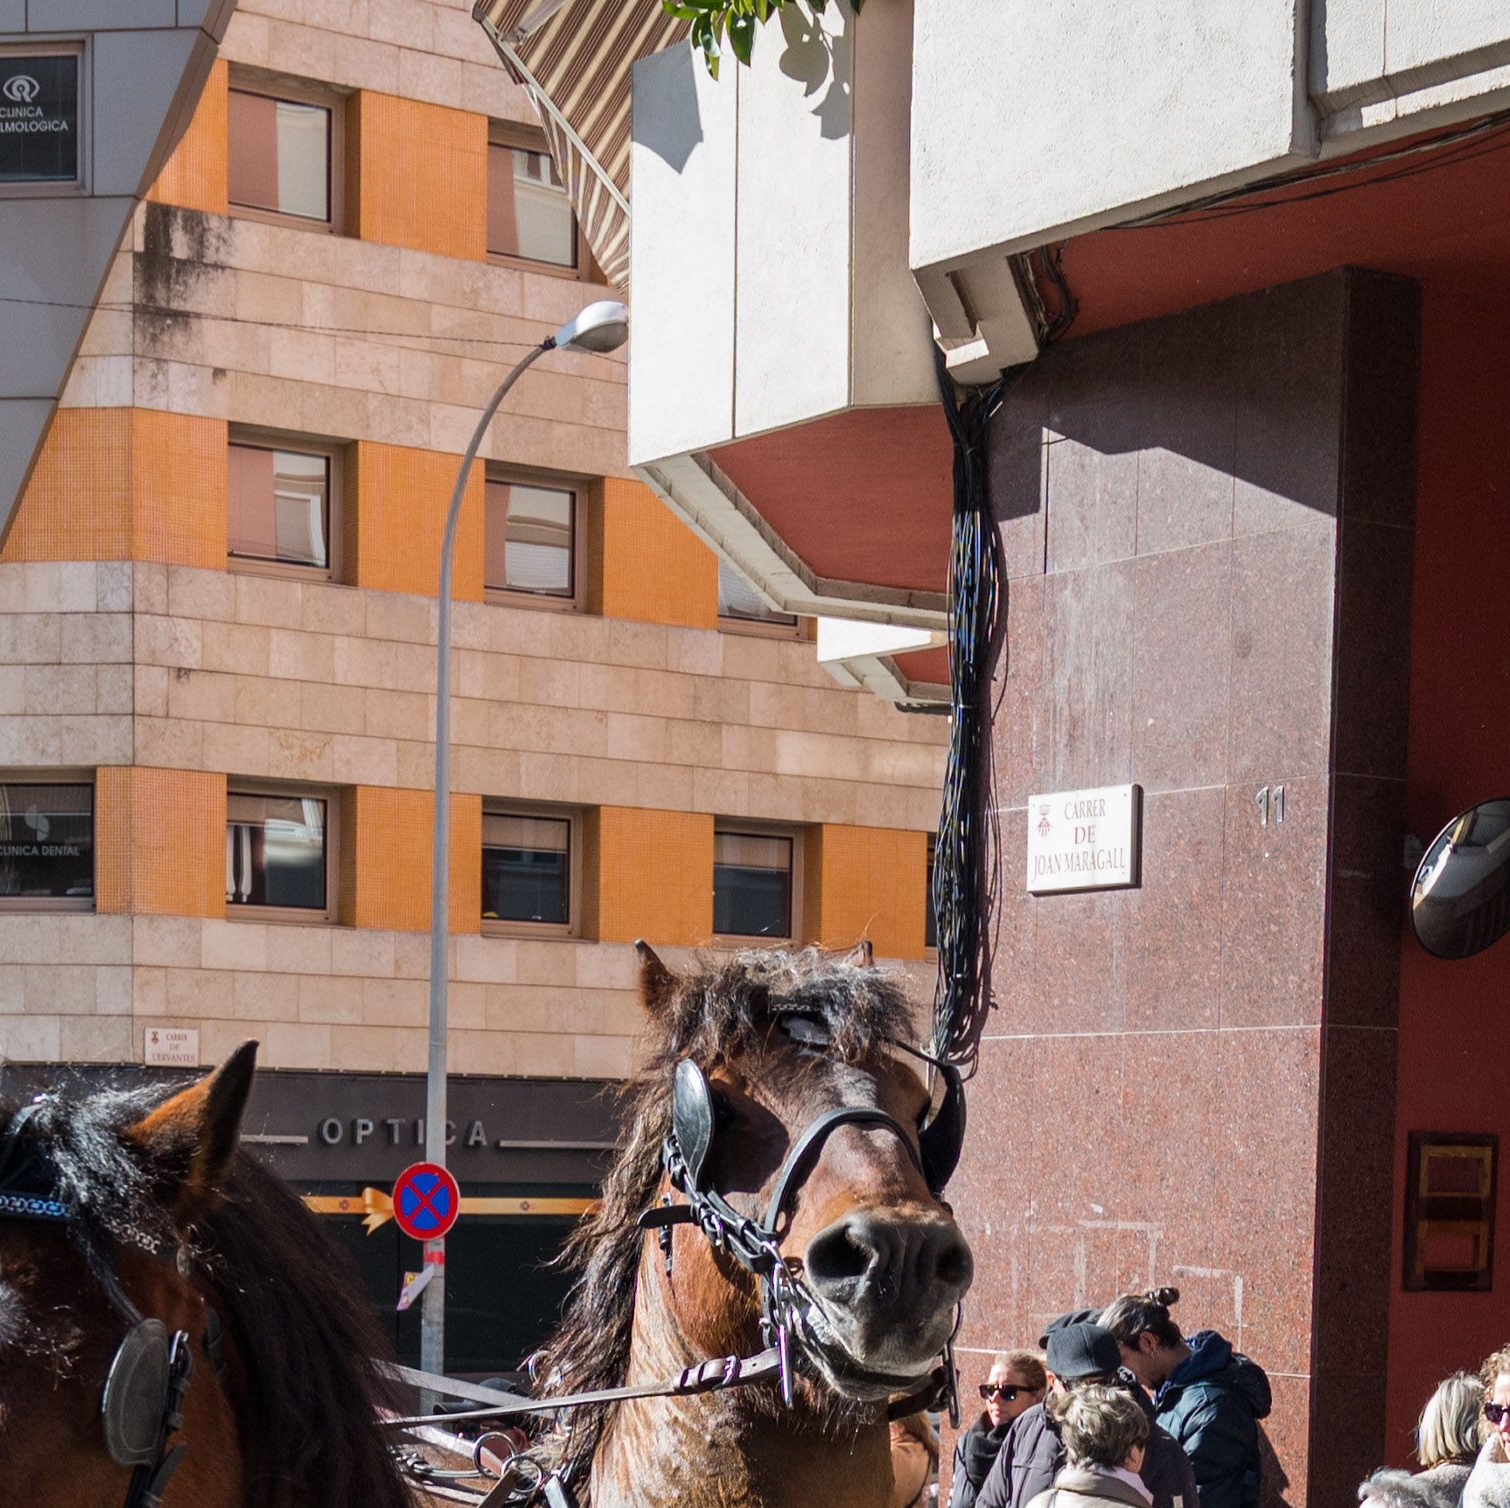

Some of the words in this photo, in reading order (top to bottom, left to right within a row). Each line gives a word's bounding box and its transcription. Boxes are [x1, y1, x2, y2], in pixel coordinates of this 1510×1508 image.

[1065, 799, 1106, 820] CARRER
[1255, 785, 1285, 826] 11
[1075, 825, 1095, 845] DE
[42, 845, 80, 856] DENTAL
[1034, 853, 1061, 881] JOAN
[1064, 848, 1125, 873] MARAGALL
[169, 1043, 179, 1051] DE
[152, 1053, 195, 1062] CERVANTES
